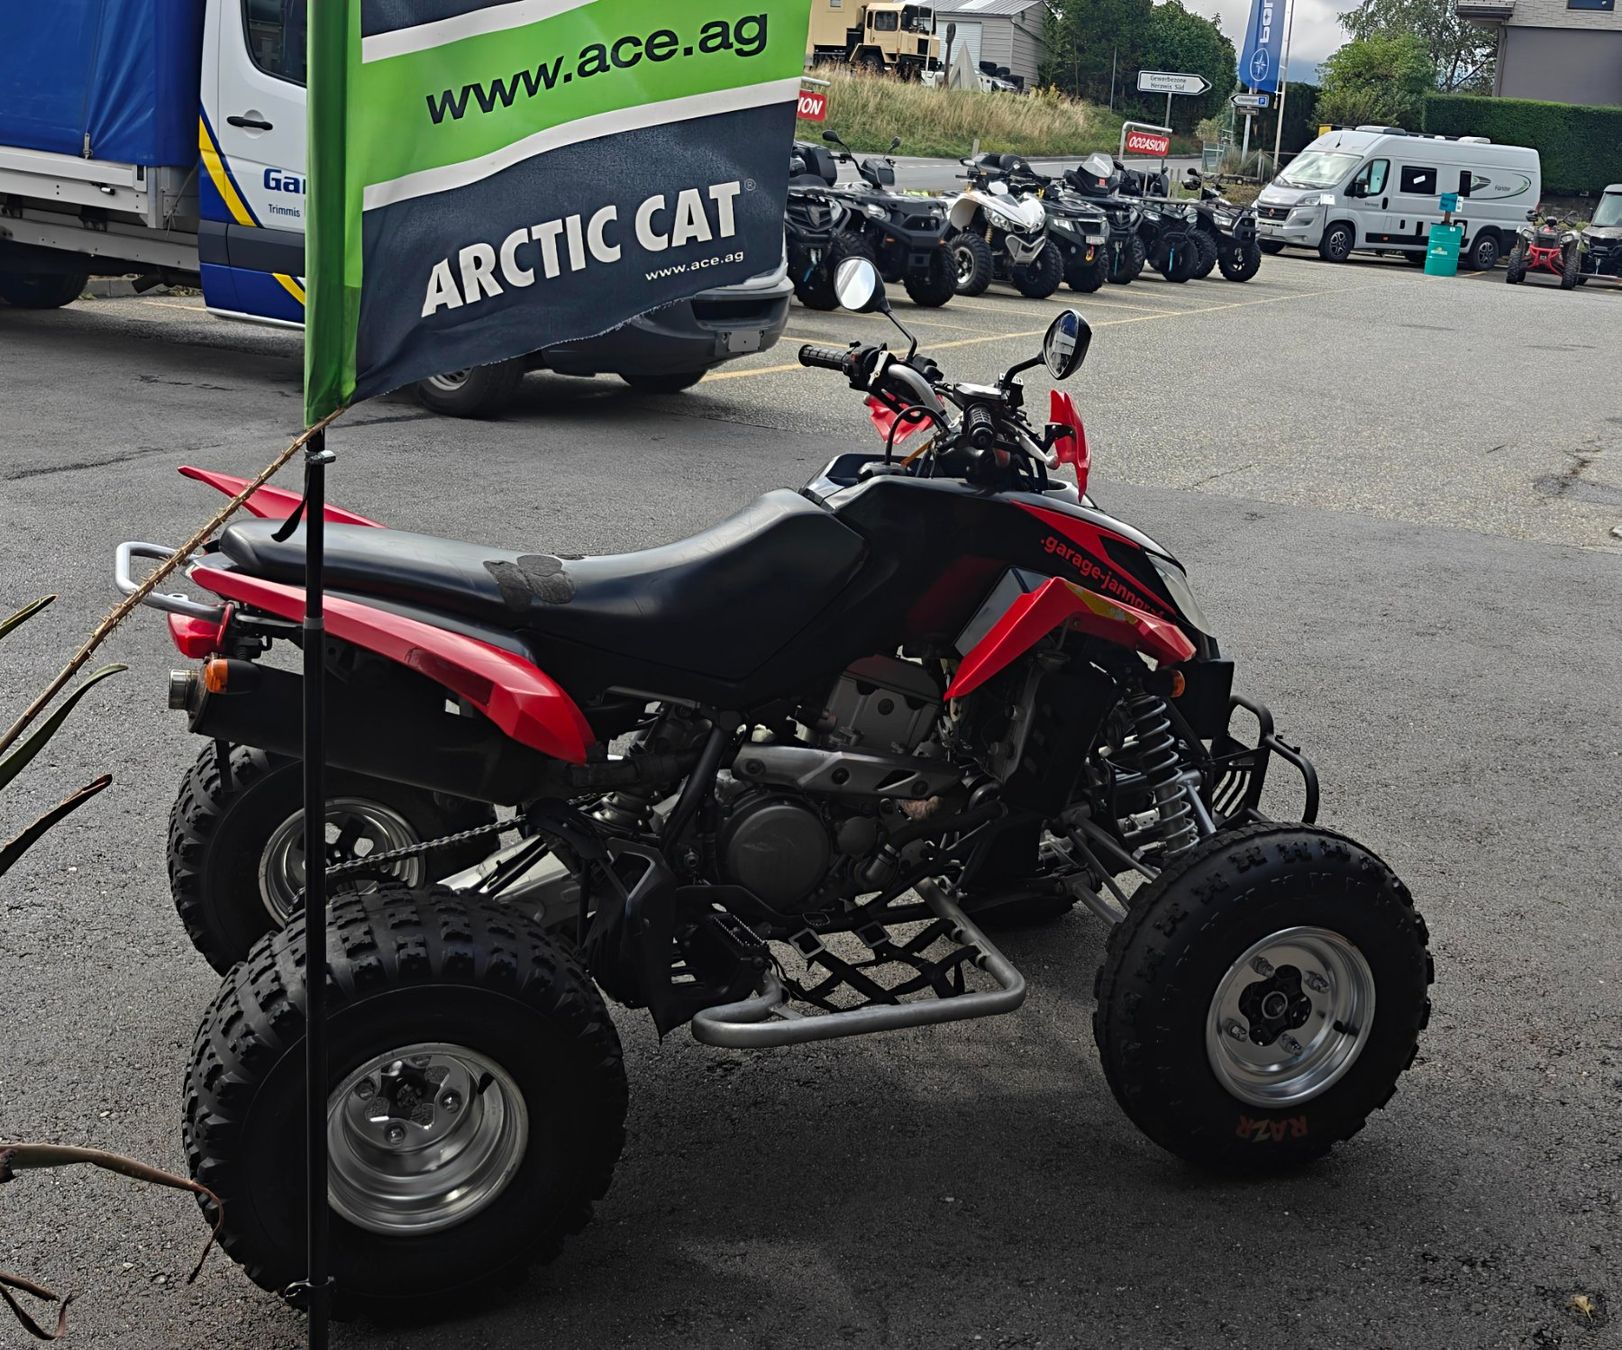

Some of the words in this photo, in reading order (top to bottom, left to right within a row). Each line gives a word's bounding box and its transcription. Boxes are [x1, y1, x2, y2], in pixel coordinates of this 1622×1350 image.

[426, 13, 768, 125] www.ace.ag
[1128, 136, 1168, 152] OCCASION
[268, 203, 301, 218] Trimmis
[421, 204, 622, 318] ARCTIC
[635, 180, 741, 252] CAT
[645, 251, 744, 281] www.ace.ag
[1235, 1115, 1308, 1143] RAZR
